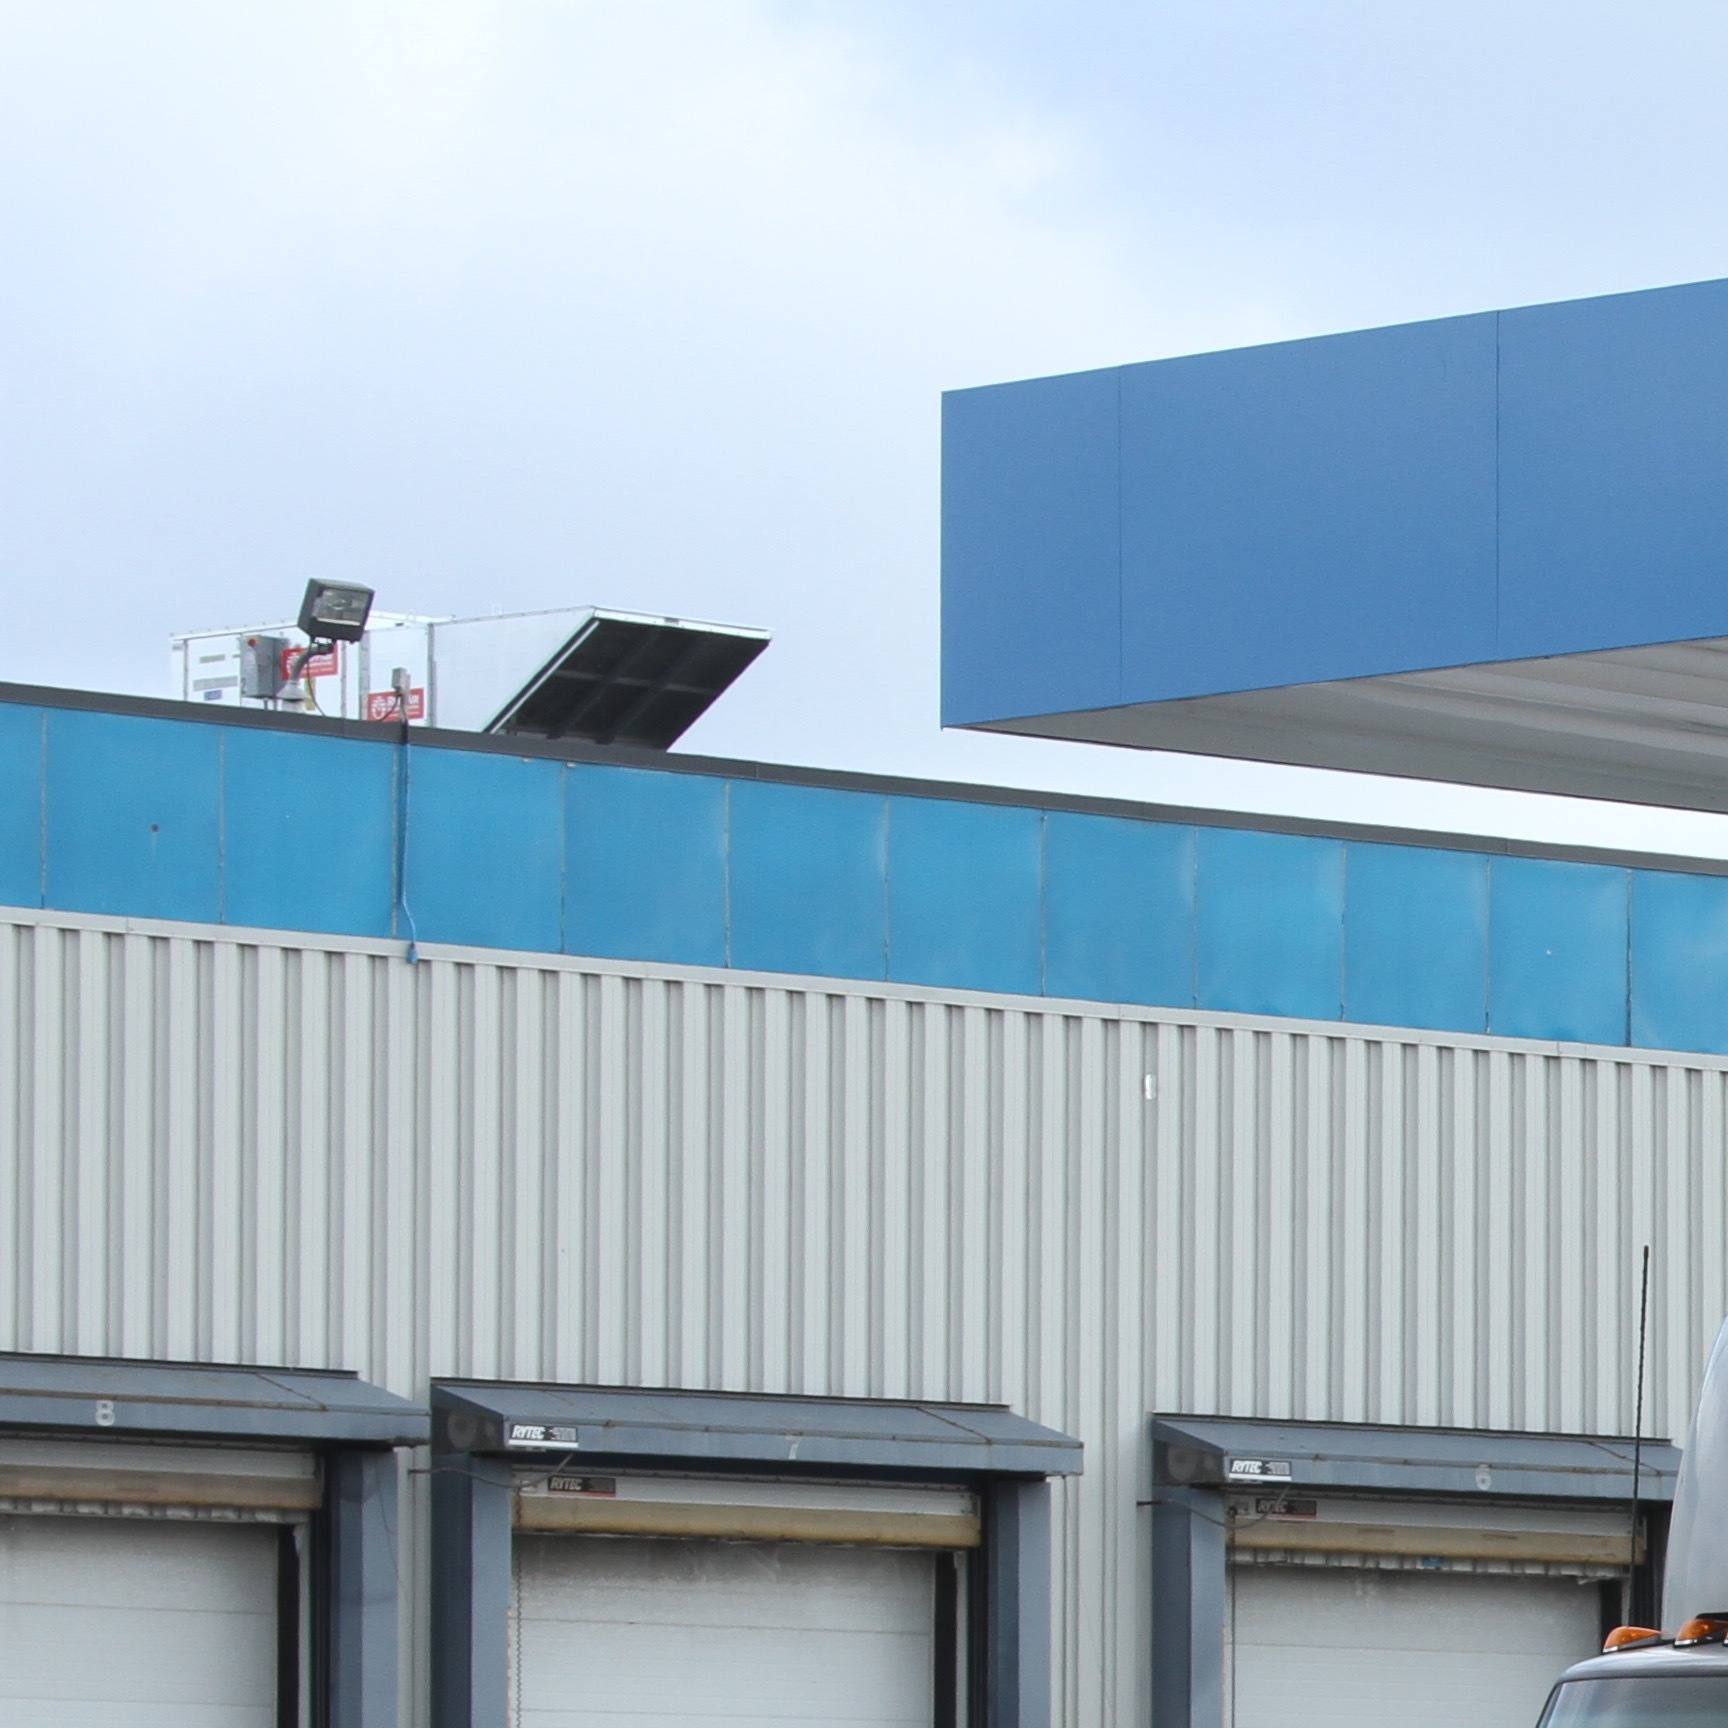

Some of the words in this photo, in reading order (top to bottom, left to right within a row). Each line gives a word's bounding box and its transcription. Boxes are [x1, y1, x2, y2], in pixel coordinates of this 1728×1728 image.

[94, 1400, 115, 1427] 8
[512, 1425, 546, 1439] RYTEC
[1231, 1460, 1262, 1473] RYTEC
[550, 1476, 583, 1491] RYTEC
